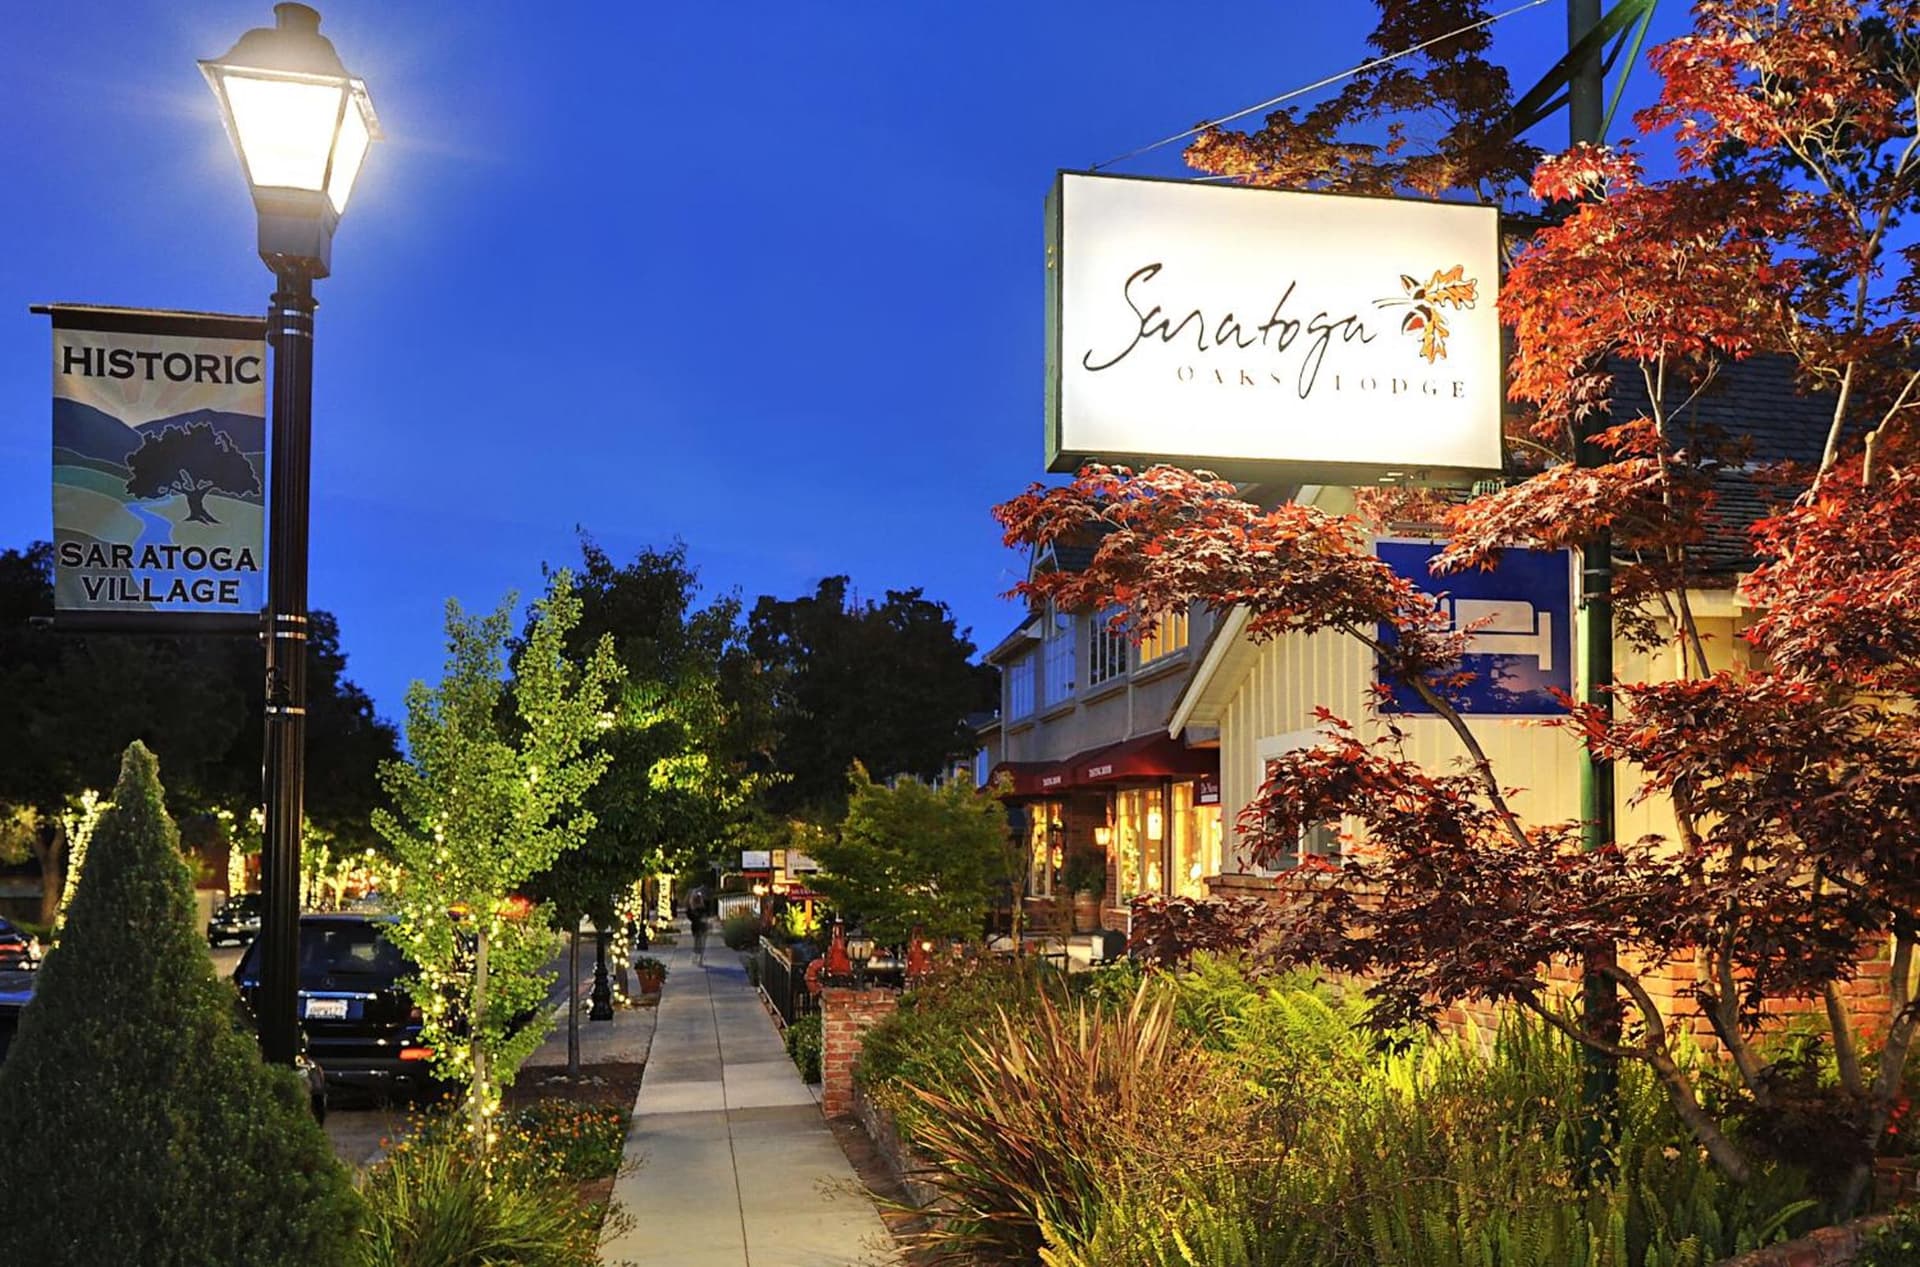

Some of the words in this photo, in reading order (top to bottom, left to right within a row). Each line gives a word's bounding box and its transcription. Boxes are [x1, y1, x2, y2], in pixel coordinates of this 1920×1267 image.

[1083, 262, 1377, 399] Saratoga
[62, 346, 262, 385] HISTORIC
[1177, 366, 1281, 386] OAKS
[1334, 374, 1466, 399] LODGE
[60, 542, 258, 572] SARATOGA
[82, 576, 241, 604] VILLAGE
